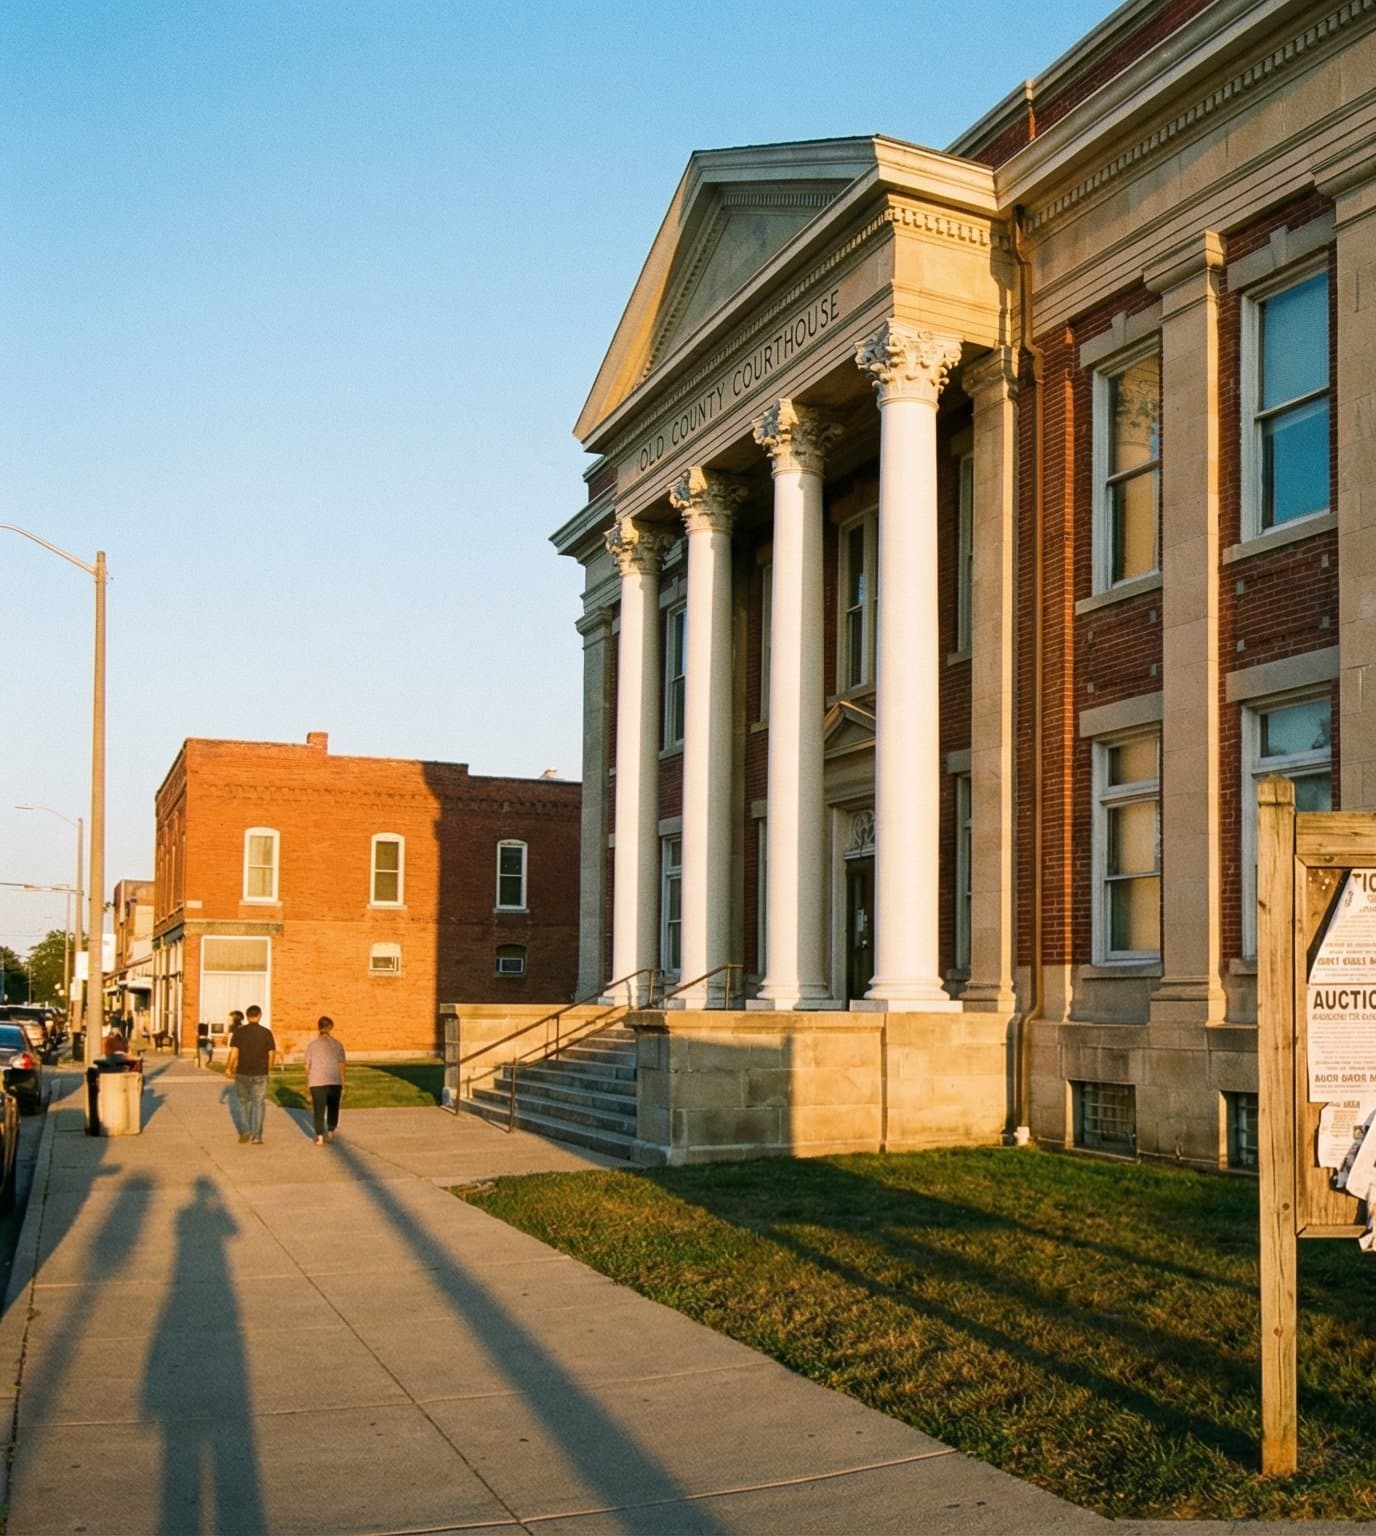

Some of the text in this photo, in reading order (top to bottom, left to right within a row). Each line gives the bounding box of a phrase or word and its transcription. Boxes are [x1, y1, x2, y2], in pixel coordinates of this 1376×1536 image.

[639, 288, 840, 472] OLD COUNTY COURTHOUSE
